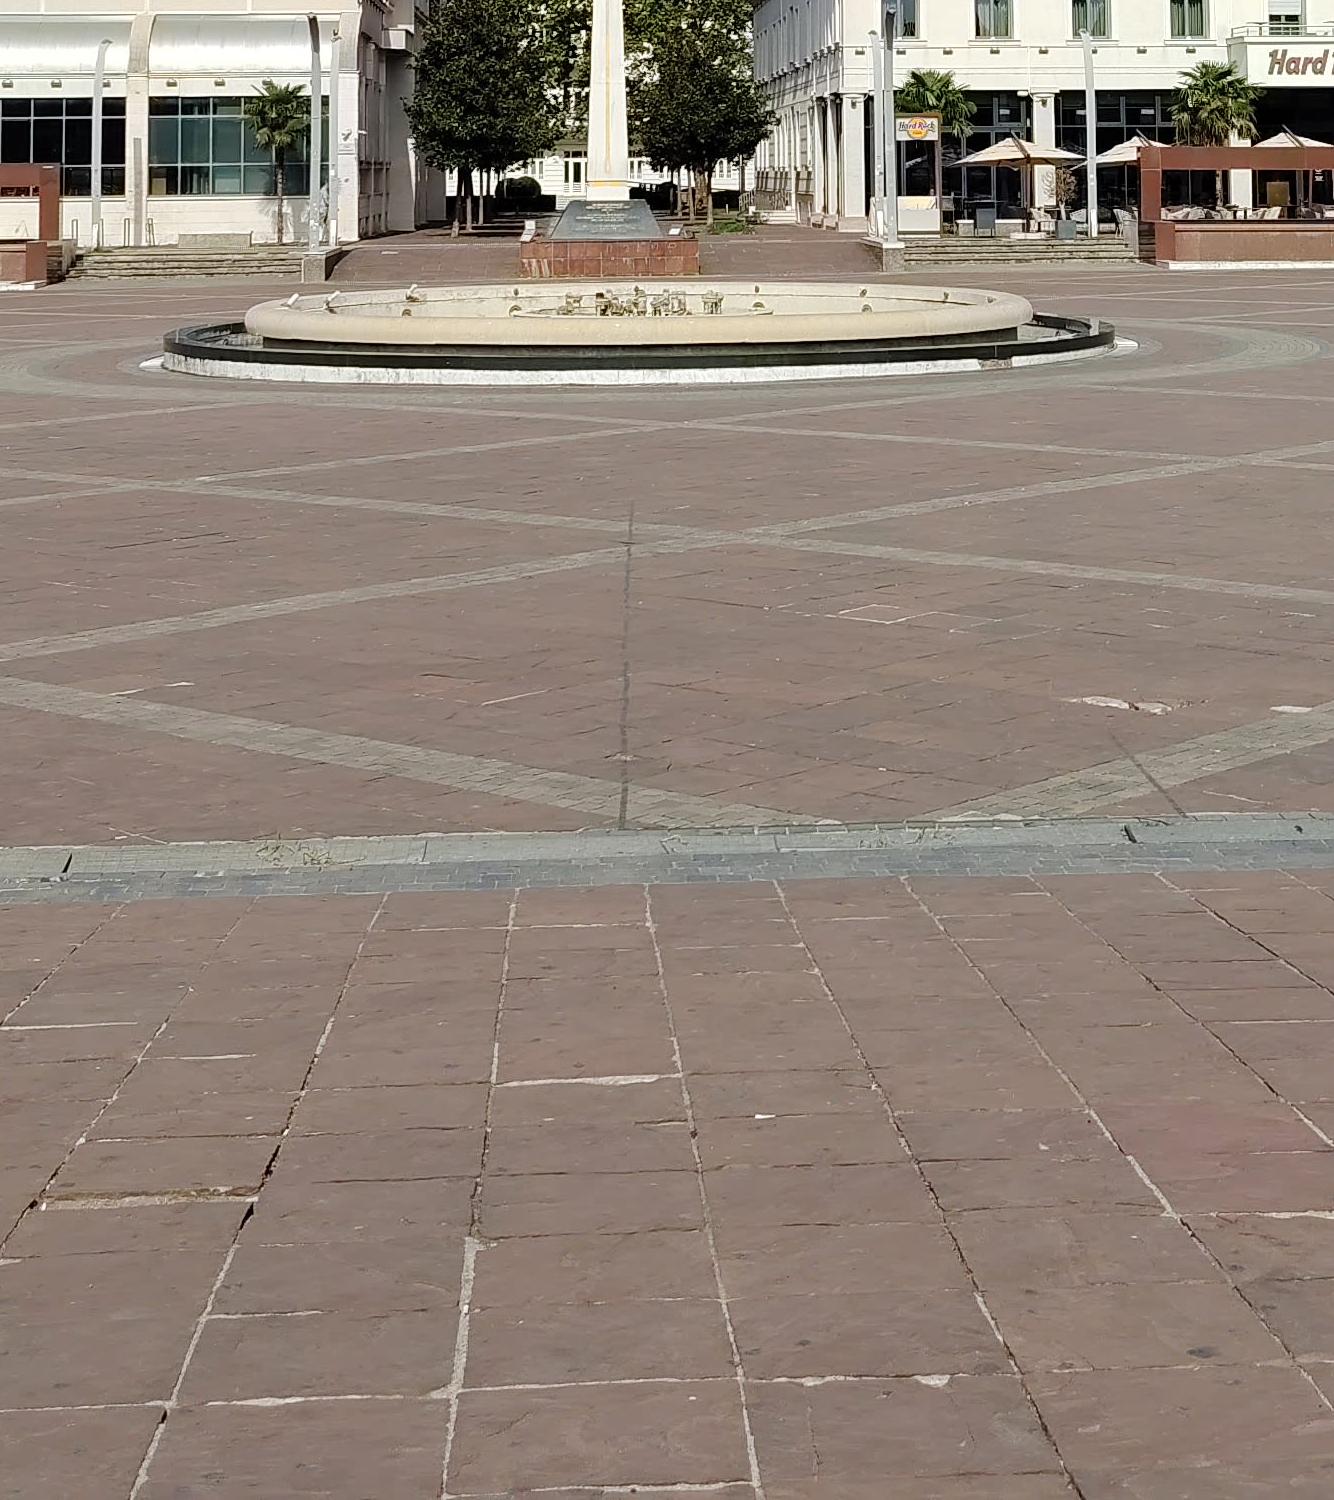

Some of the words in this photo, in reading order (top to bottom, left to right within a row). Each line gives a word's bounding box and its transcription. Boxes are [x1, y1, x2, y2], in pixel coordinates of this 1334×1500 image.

[1268, 49, 1329, 75] Hard
[898, 121, 917, 131] Hard
[918, 121, 936, 132] Rock
